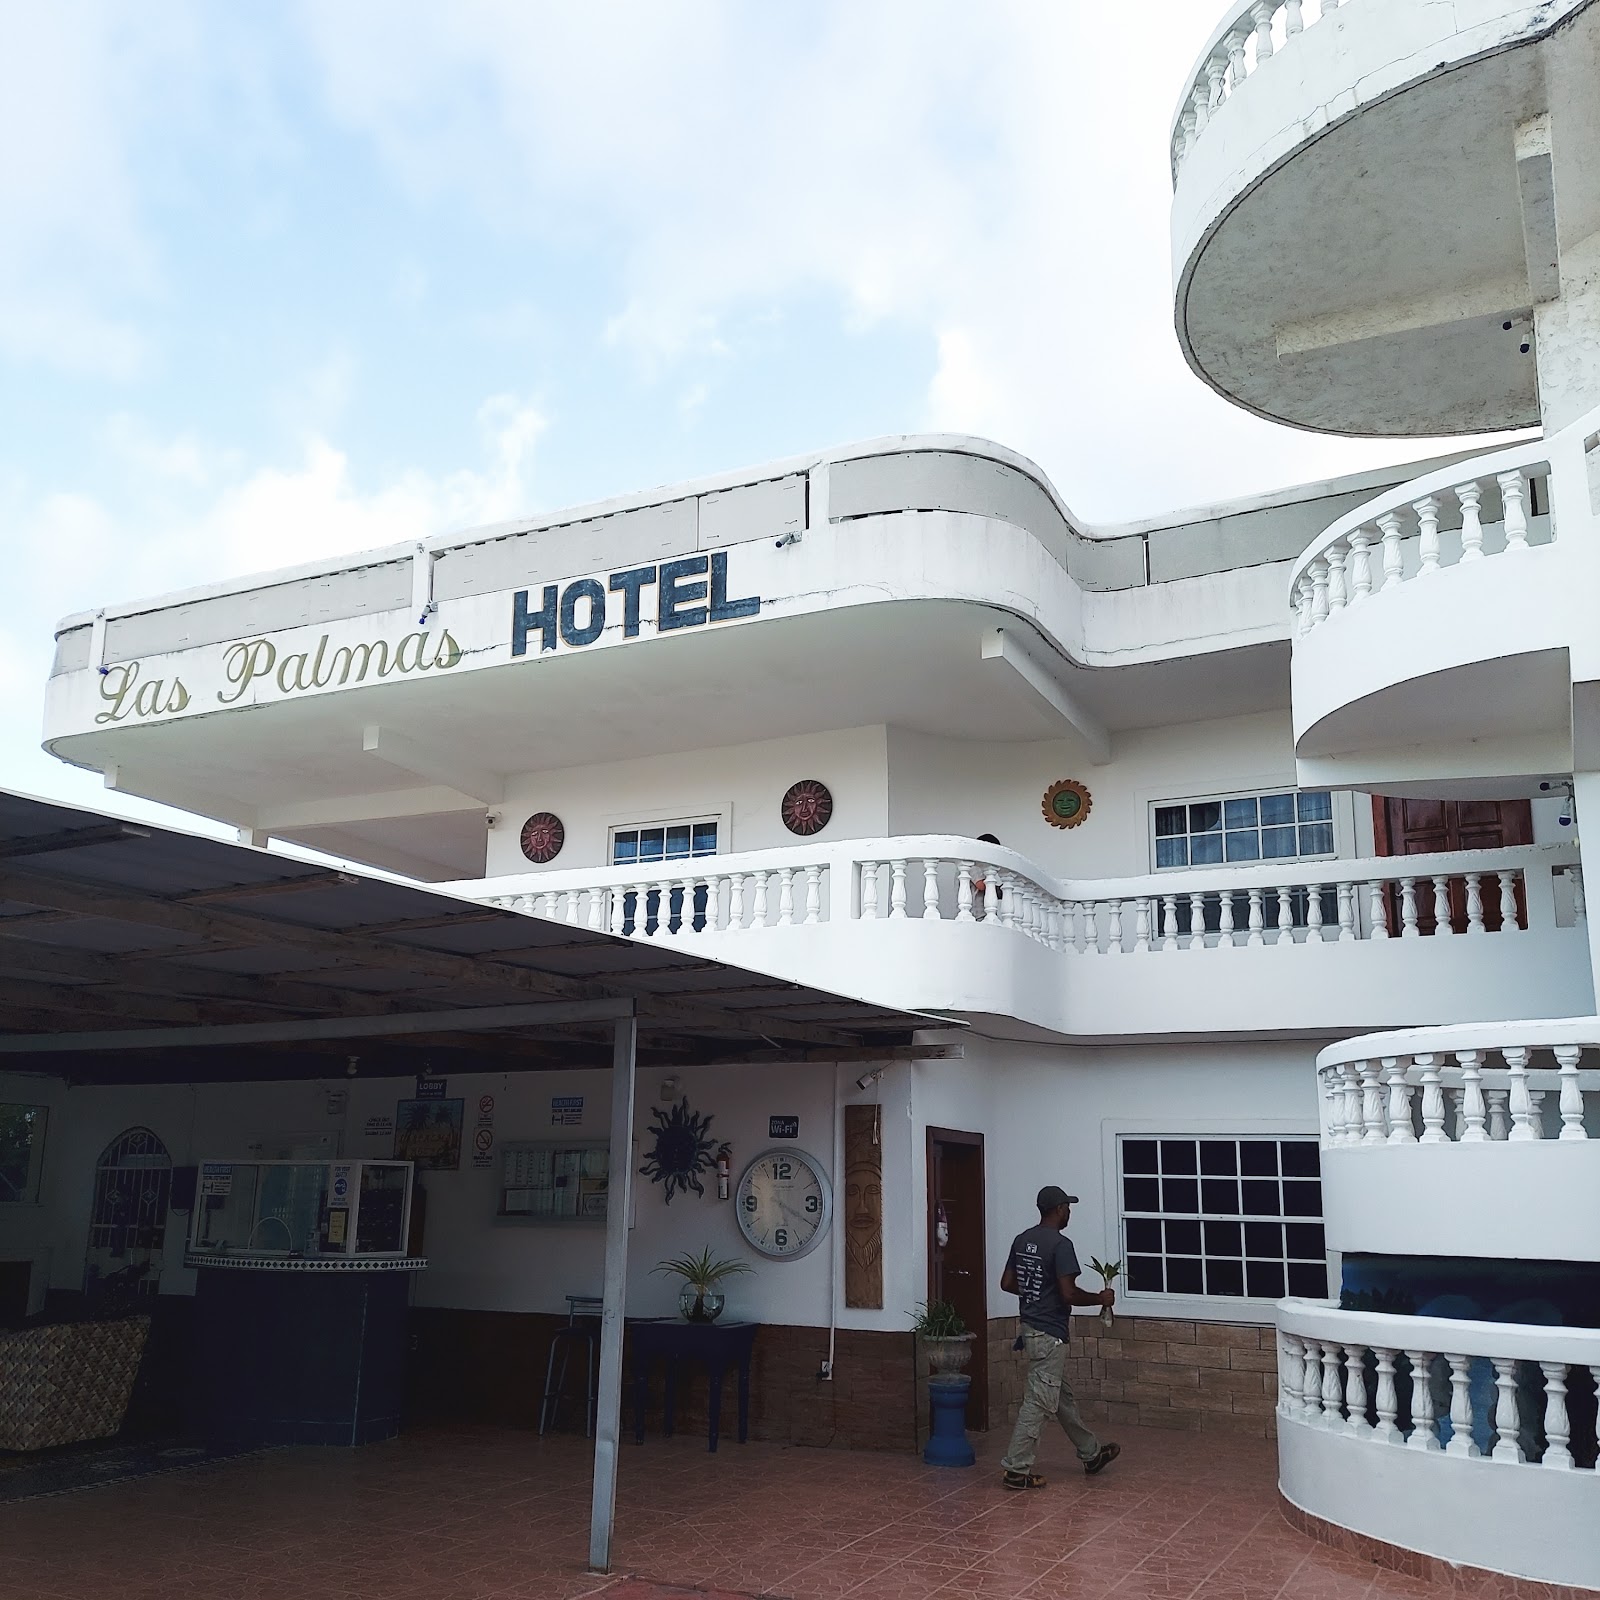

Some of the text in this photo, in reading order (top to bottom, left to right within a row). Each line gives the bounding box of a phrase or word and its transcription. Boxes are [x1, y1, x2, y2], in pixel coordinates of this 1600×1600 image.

[95, 551, 761, 724] Las Palmas HOTEL
[419, 1082, 443, 1091] LOBBY
[771, 1125, 793, 1134] Wi-Fi
[772, 1163, 791, 1179] 12
[746, 1195, 757, 1212] 9
[805, 1195, 818, 1212] 3
[775, 1229, 787, 1246] 6
